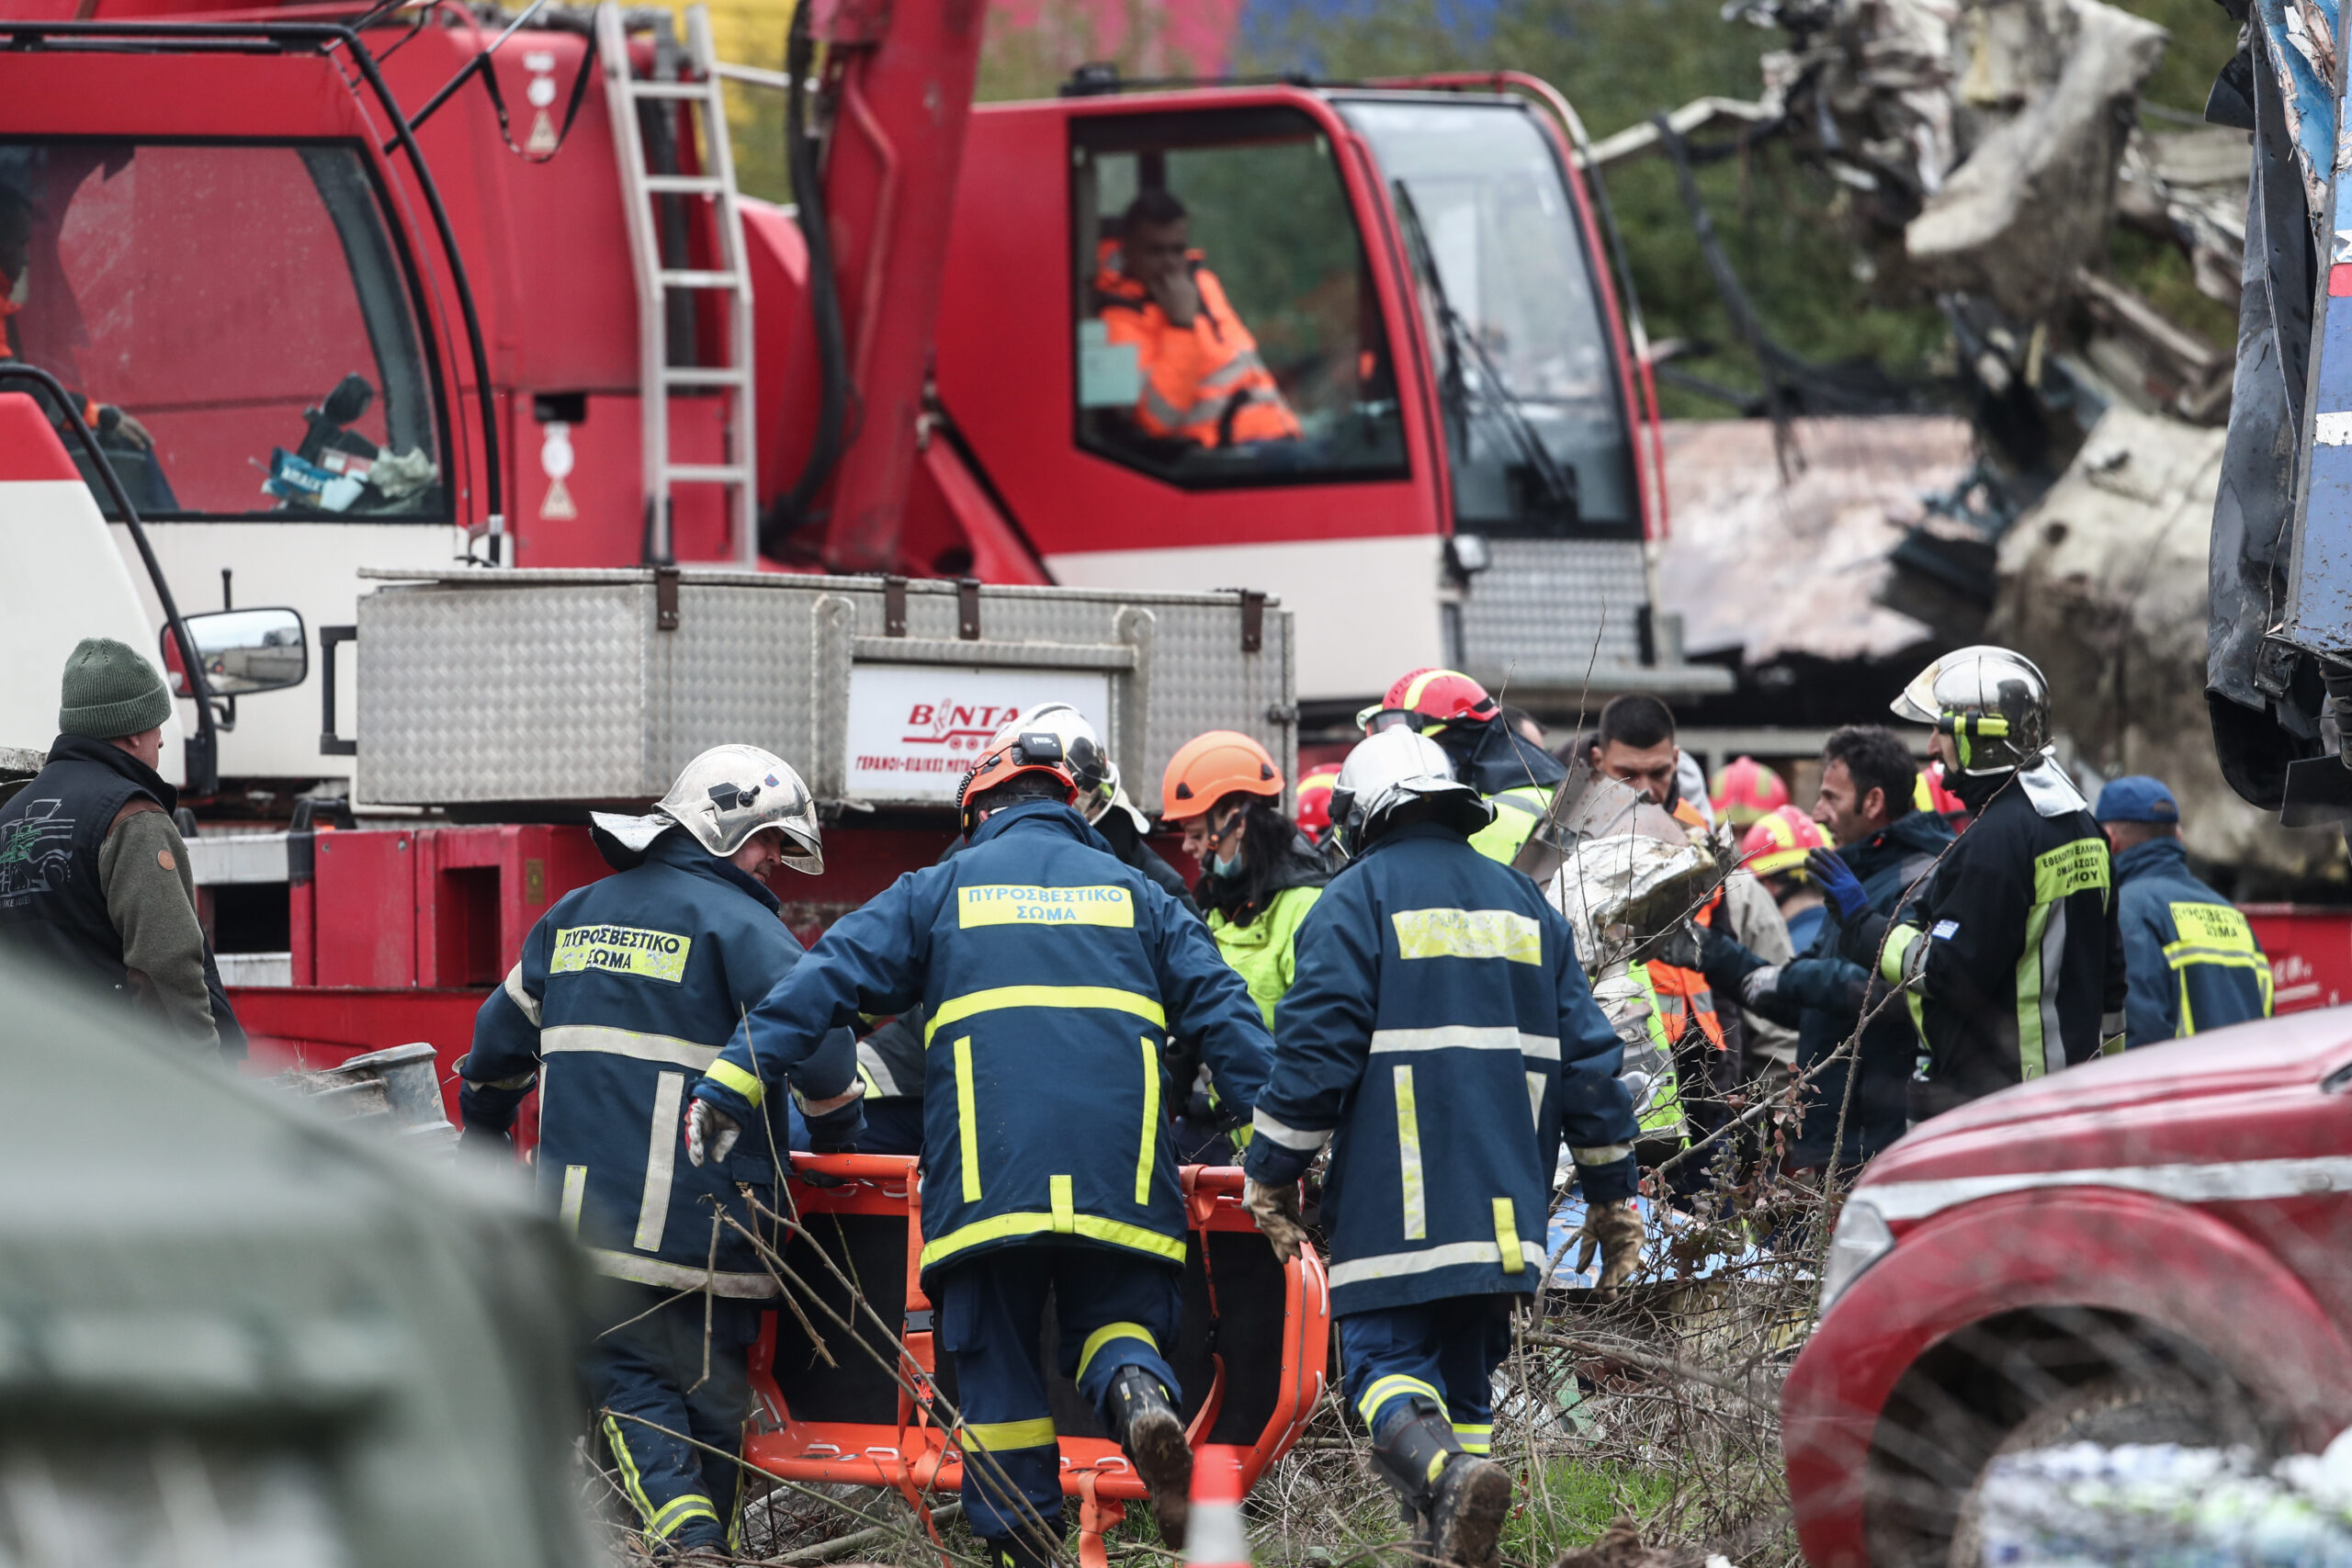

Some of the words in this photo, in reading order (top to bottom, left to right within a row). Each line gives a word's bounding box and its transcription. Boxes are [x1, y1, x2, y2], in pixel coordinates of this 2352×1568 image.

[968, 887, 1124, 904] ΠΥΡΟΣΒΕΣΤΙΚΟ
[1016, 906, 1077, 921] ΣΩΜΑ
[562, 928, 680, 953] ΠΥΡΟΣΒΕΣΤΙΚΟ
[585, 948, 632, 969] ΣΩΜΑ
